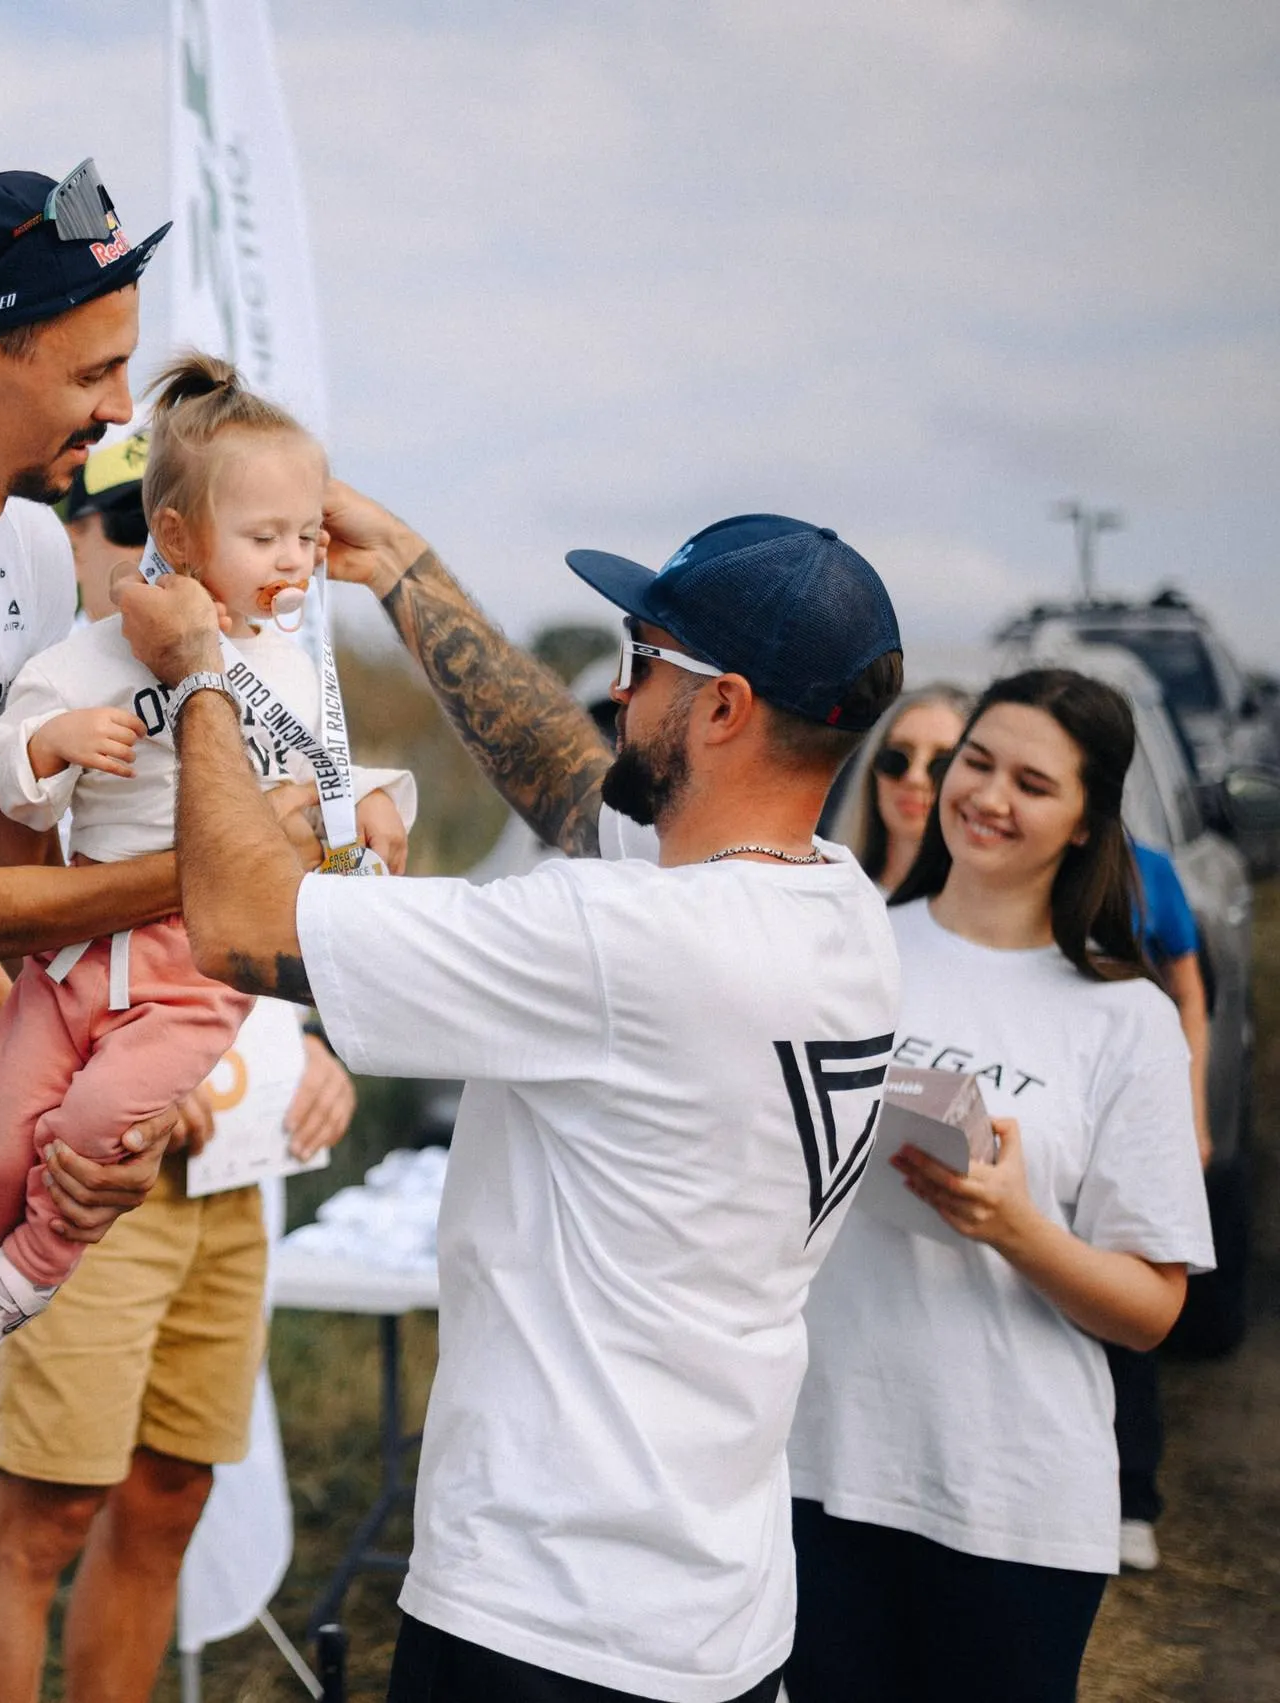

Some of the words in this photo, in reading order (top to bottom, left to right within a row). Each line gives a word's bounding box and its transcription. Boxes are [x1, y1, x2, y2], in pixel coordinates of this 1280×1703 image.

[227, 662, 270, 707] CLUB
[325, 669, 344, 732] RACING
[263, 703, 316, 750] RACING
[302, 748, 344, 801] FREGAT
